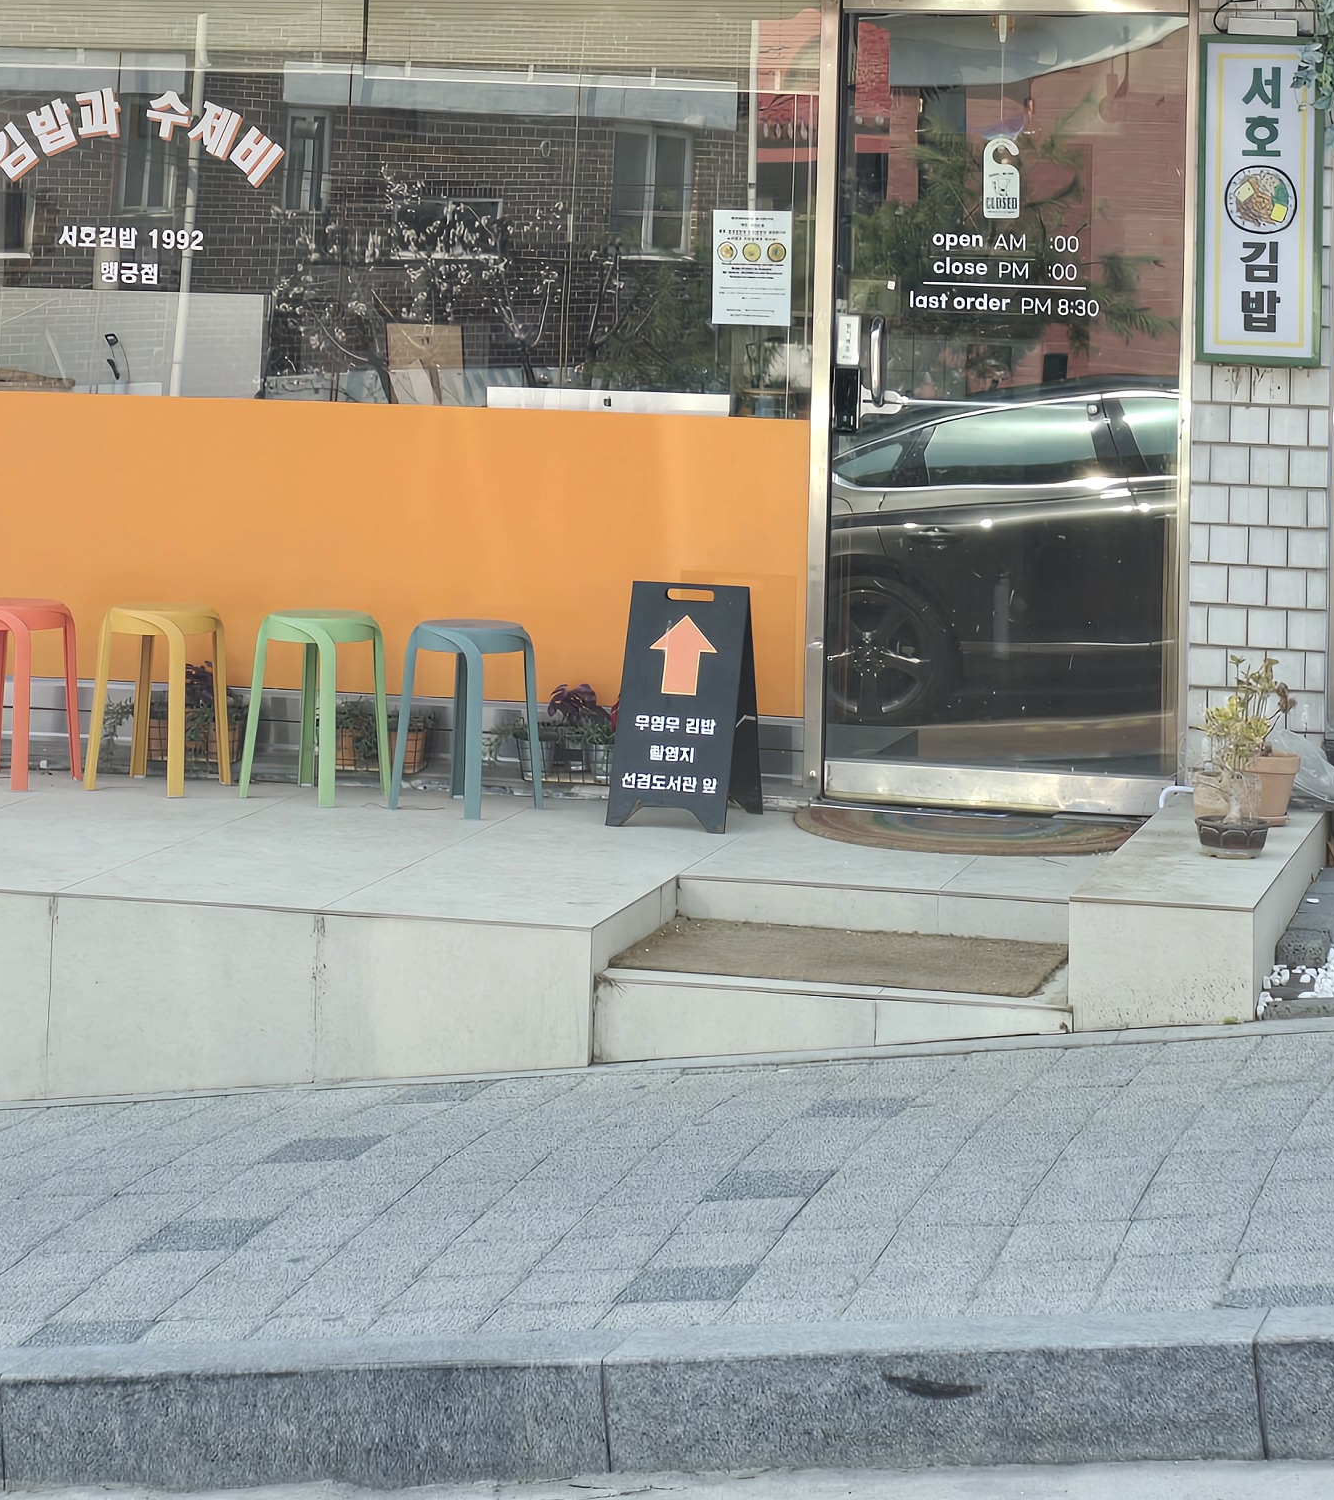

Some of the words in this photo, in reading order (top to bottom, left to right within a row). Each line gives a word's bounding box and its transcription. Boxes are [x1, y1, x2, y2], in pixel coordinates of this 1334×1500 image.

[146, 90, 286, 189] 수제비
[986, 197, 1018, 209] CLOSED
[58, 225, 137, 250] 서호김밥
[149, 228, 204, 251] 1992
[932, 233, 984, 251] open
[994, 233, 1027, 251] AM
[100, 261, 159, 285] 행궁점
[933, 257, 988, 276] close
[998, 262, 1029, 279] PM
[909, 290, 948, 309] last
[953, 293, 1010, 311] order
[1021, 297, 1052, 315] PM
[1057, 299, 1100, 318] 8:30
[685, 717, 717, 736] 김밥
[701, 777, 718, 794] 앞
